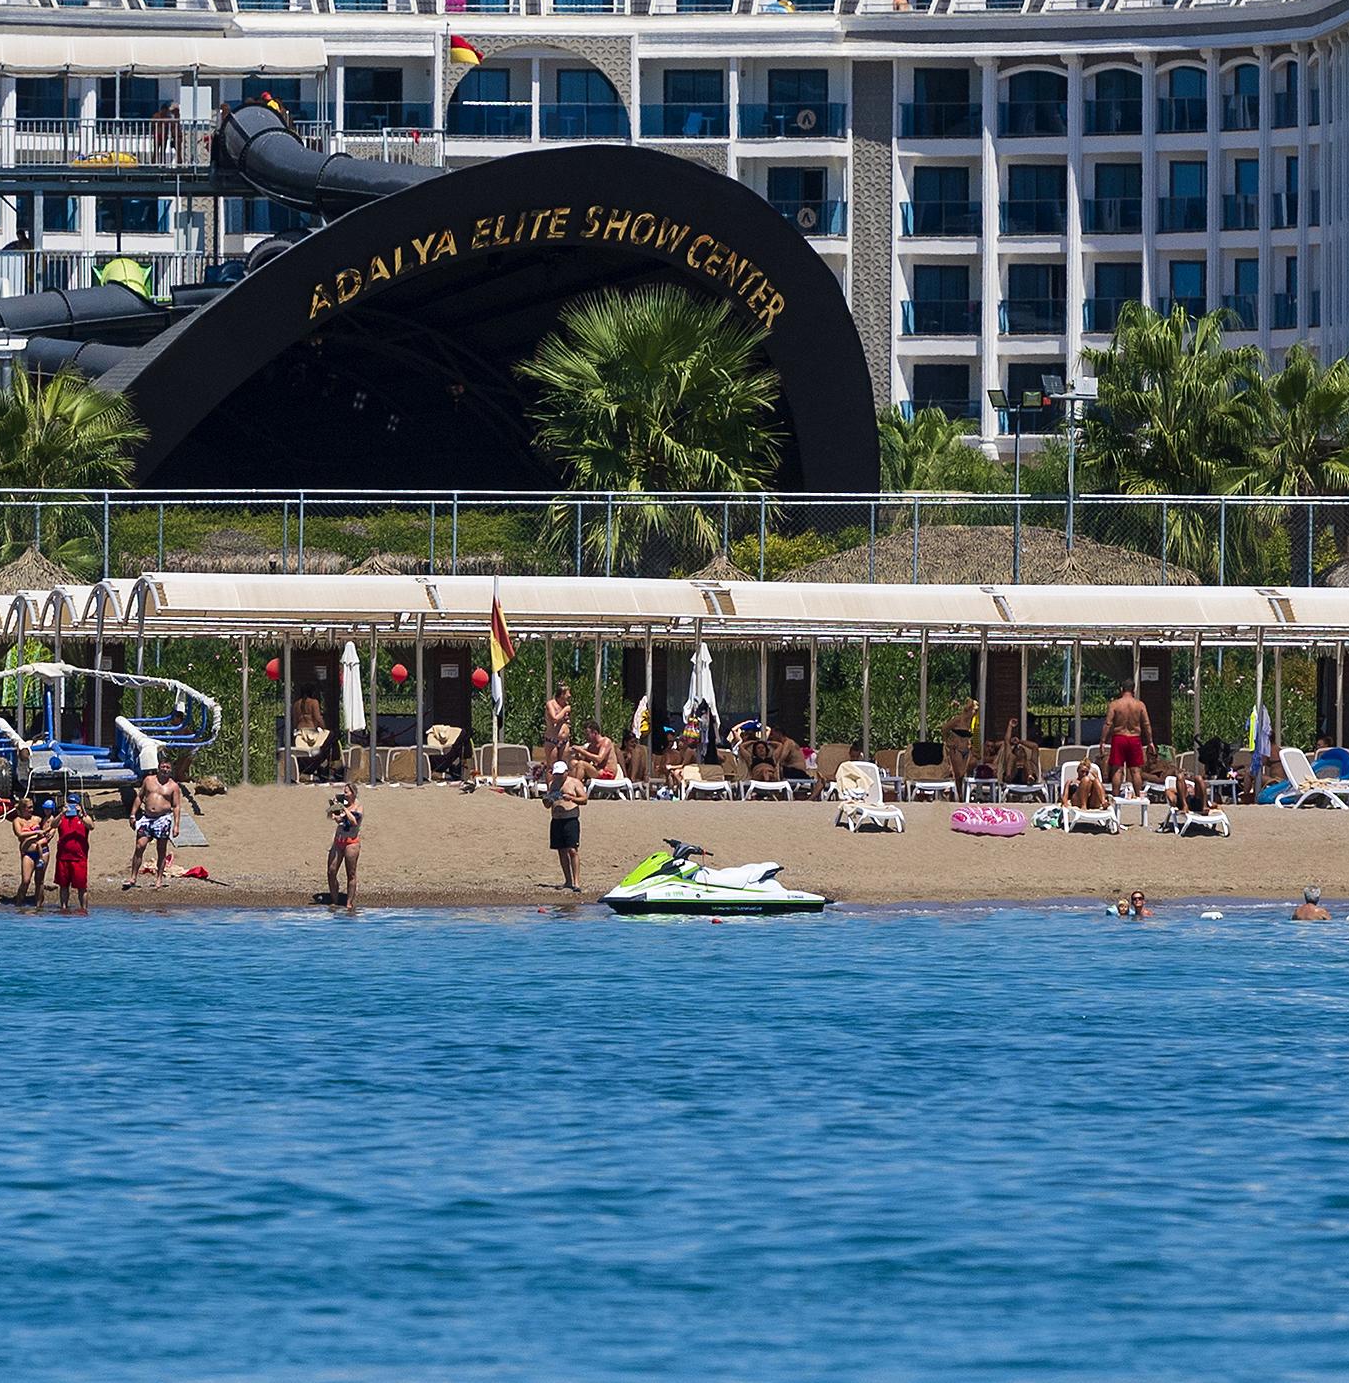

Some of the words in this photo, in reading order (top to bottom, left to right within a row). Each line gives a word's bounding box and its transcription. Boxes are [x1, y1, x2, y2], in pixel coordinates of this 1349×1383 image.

[309, 229, 458, 320] ADALYA
[471, 207, 571, 249] ELITE
[580, 204, 691, 254] SHOW
[686, 233, 785, 329] CENTER
